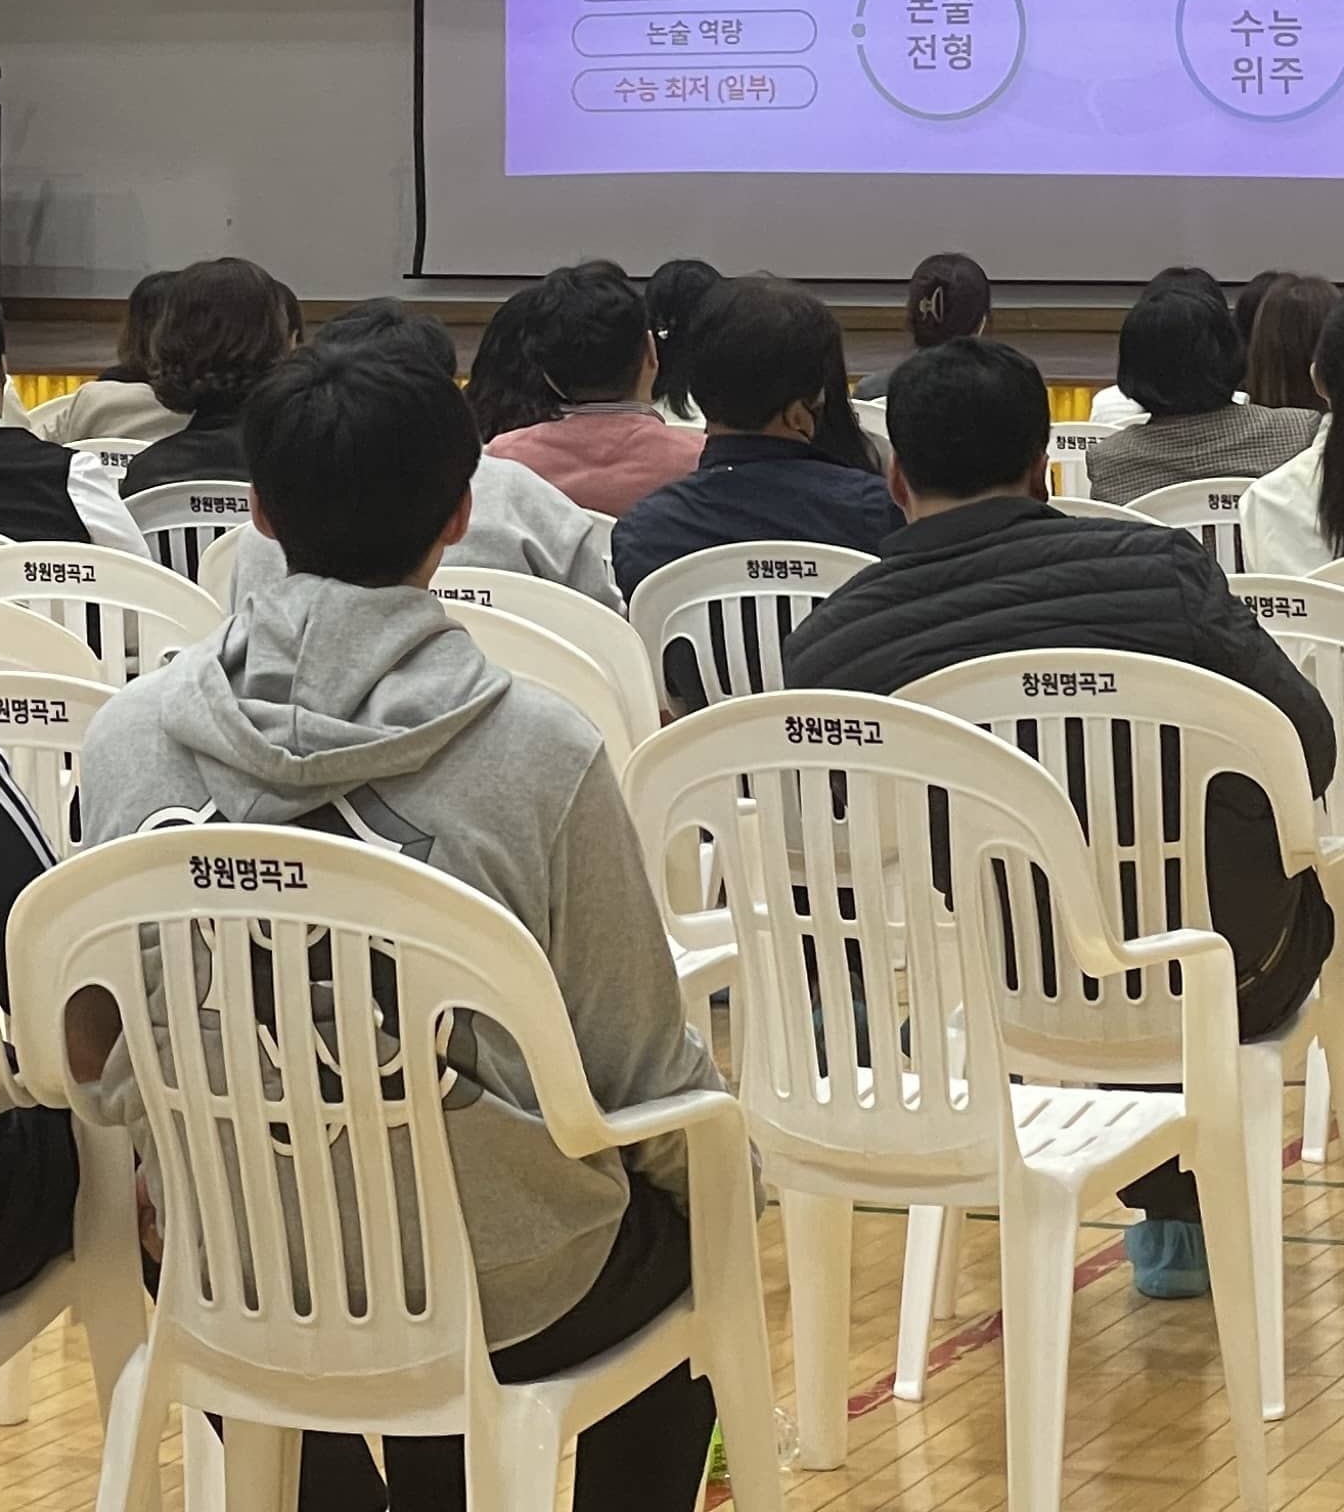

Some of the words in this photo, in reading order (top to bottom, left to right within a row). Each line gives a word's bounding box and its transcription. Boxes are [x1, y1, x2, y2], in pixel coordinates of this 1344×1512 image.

[646, 21, 692, 47] 논술
[697, 18, 744, 47] 역량
[1230, 9, 1304, 48] 수능
[906, 33, 974, 72] 전형
[614, 77, 660, 103] 수능
[664, 75, 710, 104] 최저
[717, 74, 777, 104] (일부)
[1231, 55, 1304, 95] 위주
[189, 495, 250, 515] 창원명곡고
[23, 561, 97, 584] 창원명곡고
[746, 559, 819, 580] 창원명곡고
[1021, 672, 1118, 697] 창원명곡고
[784, 715, 884, 746] 창원명곡고
[189, 855, 308, 892] 창원명곡고
